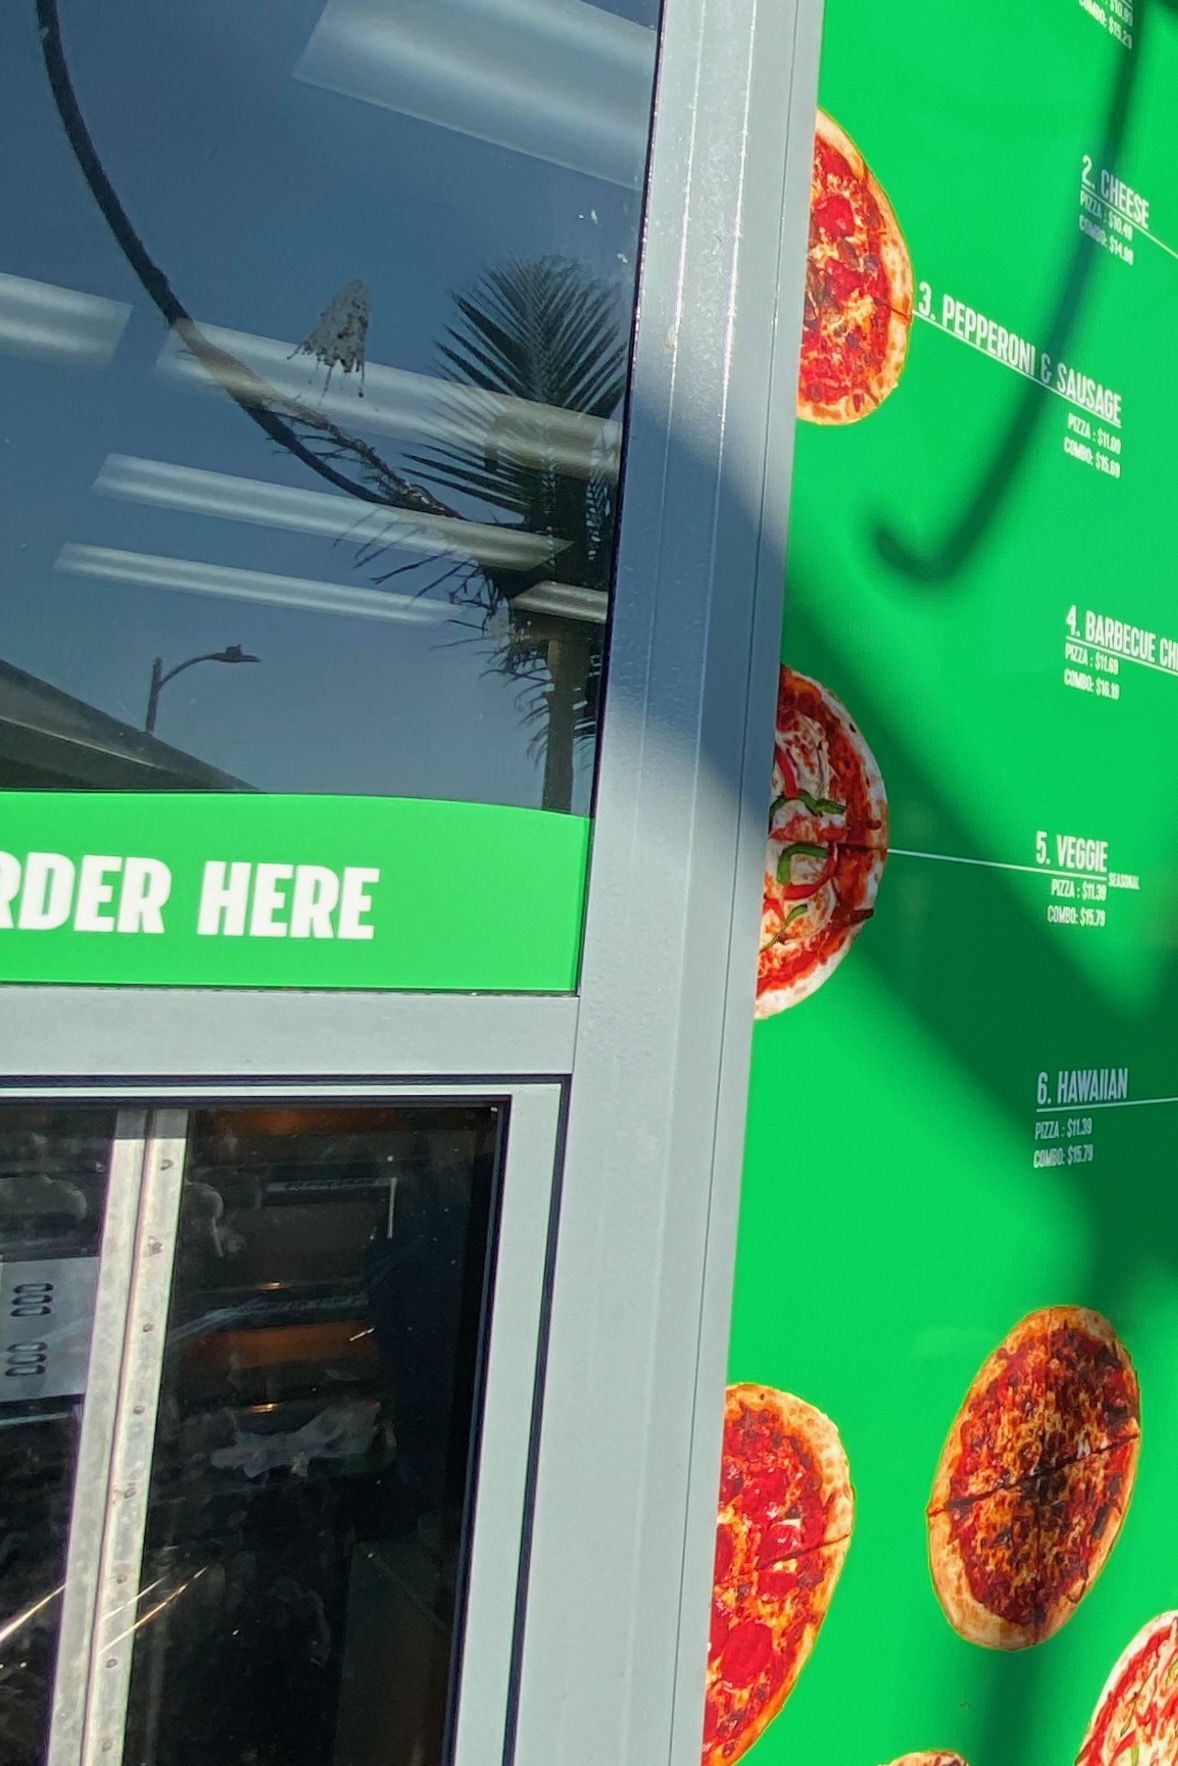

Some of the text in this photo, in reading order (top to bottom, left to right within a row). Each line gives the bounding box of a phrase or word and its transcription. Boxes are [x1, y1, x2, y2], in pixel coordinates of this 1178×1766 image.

[1080, 189, 1102, 219] PIZZA
[1082, 154, 1150, 230] 2. CHEESE
[918, 281, 1121, 426] 3. PEPPERONI & SAUSAGE
[1067, 412, 1091, 440] PIZZA
[1064, 436, 1094, 466] COMBO:
[1066, 604, 1081, 637] 4.
[1085, 609, 1156, 663] BARBECUE
[1065, 643, 1089, 666] PIZZA
[1064, 668, 1094, 692] COMBO:
[1036, 831, 1108, 872] 5. VEGGIE
[1051, 878, 1075, 898] PIZZA
[1108, 872, 1140, 890] SEASONAL
[198, 861, 380, 940] HERE
[1047, 905, 1078, 924] COMBO:
[1037, 1068, 1128, 1104] 6. HAWAIIAN
[1035, 1121, 1059, 1140] PIZZA
[1067, 1118, 1092, 1138] $11.39
[1034, 1144, 1093, 1168] COMBO: $15.79
